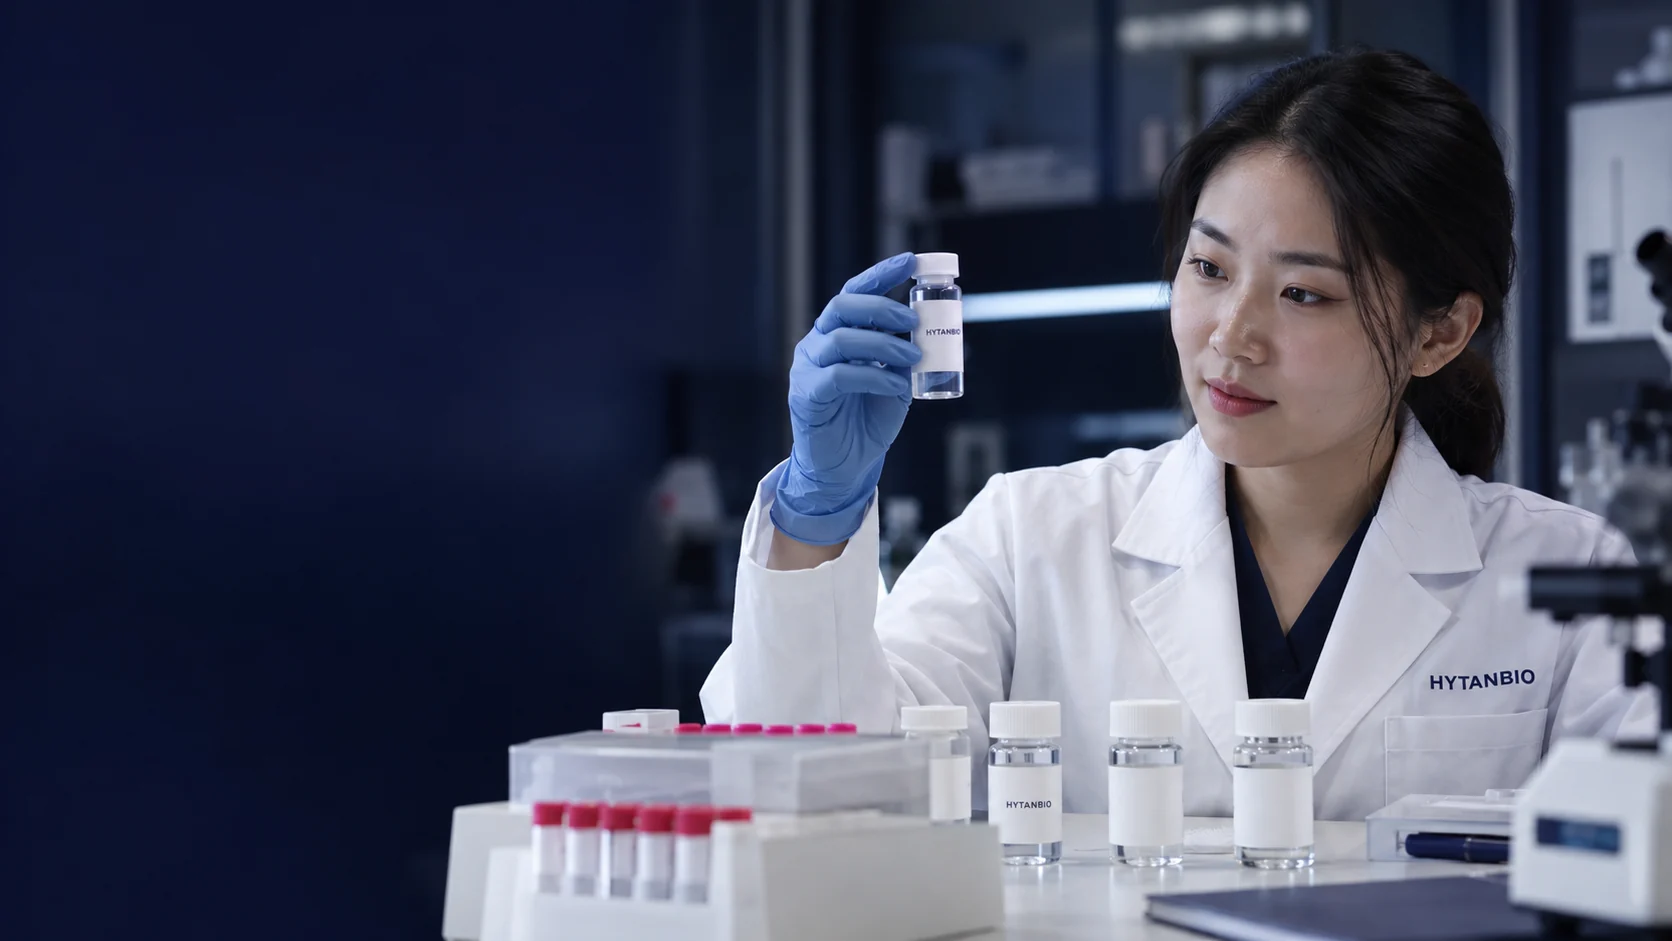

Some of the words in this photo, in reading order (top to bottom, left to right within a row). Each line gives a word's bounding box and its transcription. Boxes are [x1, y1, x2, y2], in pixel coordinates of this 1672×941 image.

[926, 328, 962, 336] HYTANBIO
[1430, 669, 1535, 690] HYTANBIO
[1006, 800, 1052, 809] HYTANBIO
